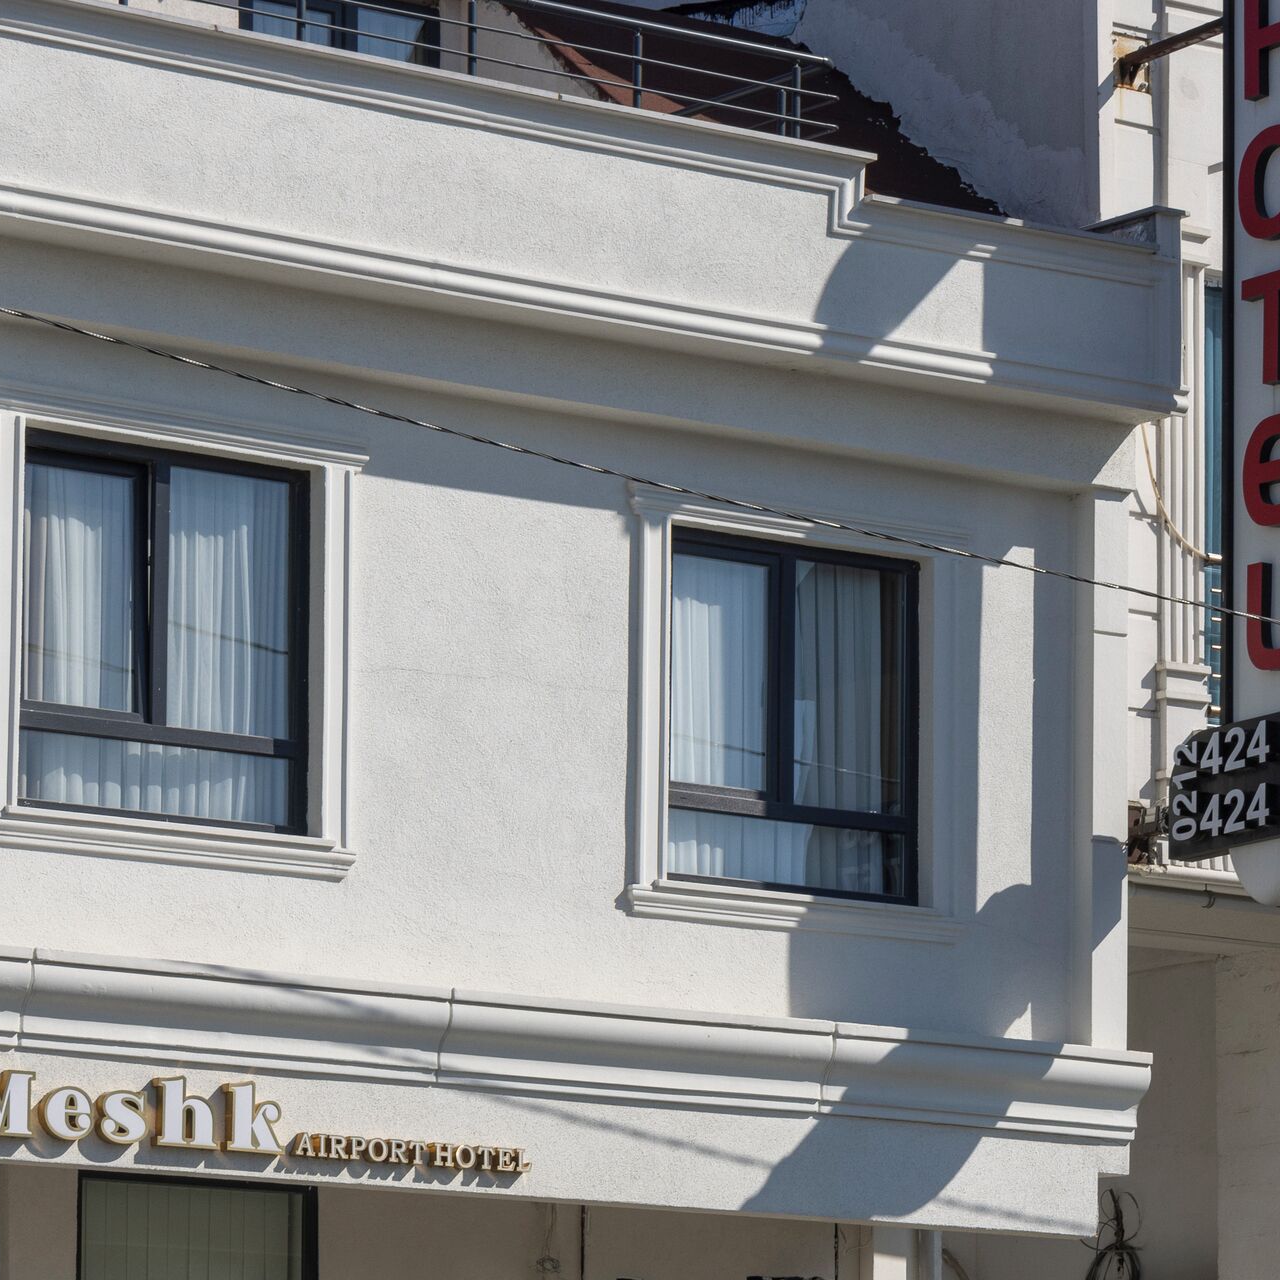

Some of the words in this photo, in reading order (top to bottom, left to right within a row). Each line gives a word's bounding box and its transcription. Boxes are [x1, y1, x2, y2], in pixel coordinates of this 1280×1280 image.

[1200, 720, 1270, 775] 424
[1172, 741, 1197, 841] 0212
[1200, 783, 1270, 837] 424
[295, 1132, 427, 1165] AIRPORT
[433, 1141, 532, 1173] HOTEL
